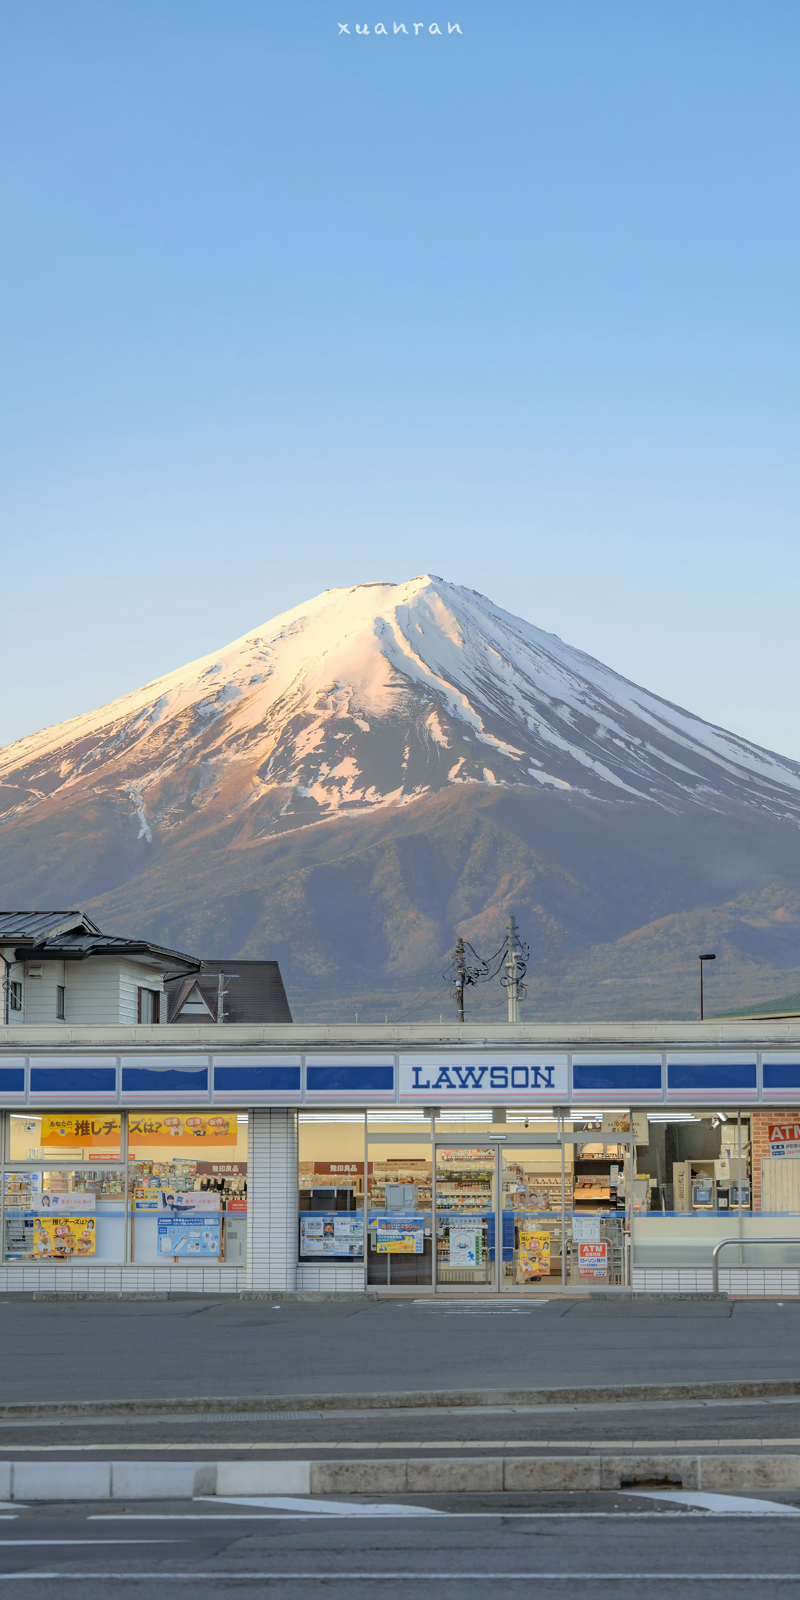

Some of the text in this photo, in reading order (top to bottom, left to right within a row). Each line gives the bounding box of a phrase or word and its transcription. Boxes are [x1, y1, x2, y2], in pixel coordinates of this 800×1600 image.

[412, 1066, 555, 1089] LAWSON
[50, 1120, 73, 1128] あなたの
[212, 1164, 239, 1173] 無印良品
[330, 1164, 357, 1172] 無印良品
[136, 1190, 144, 1199] 本
[52, 1218, 88, 1226] 推しチーズは?
[582, 1245, 602, 1253] ATM
